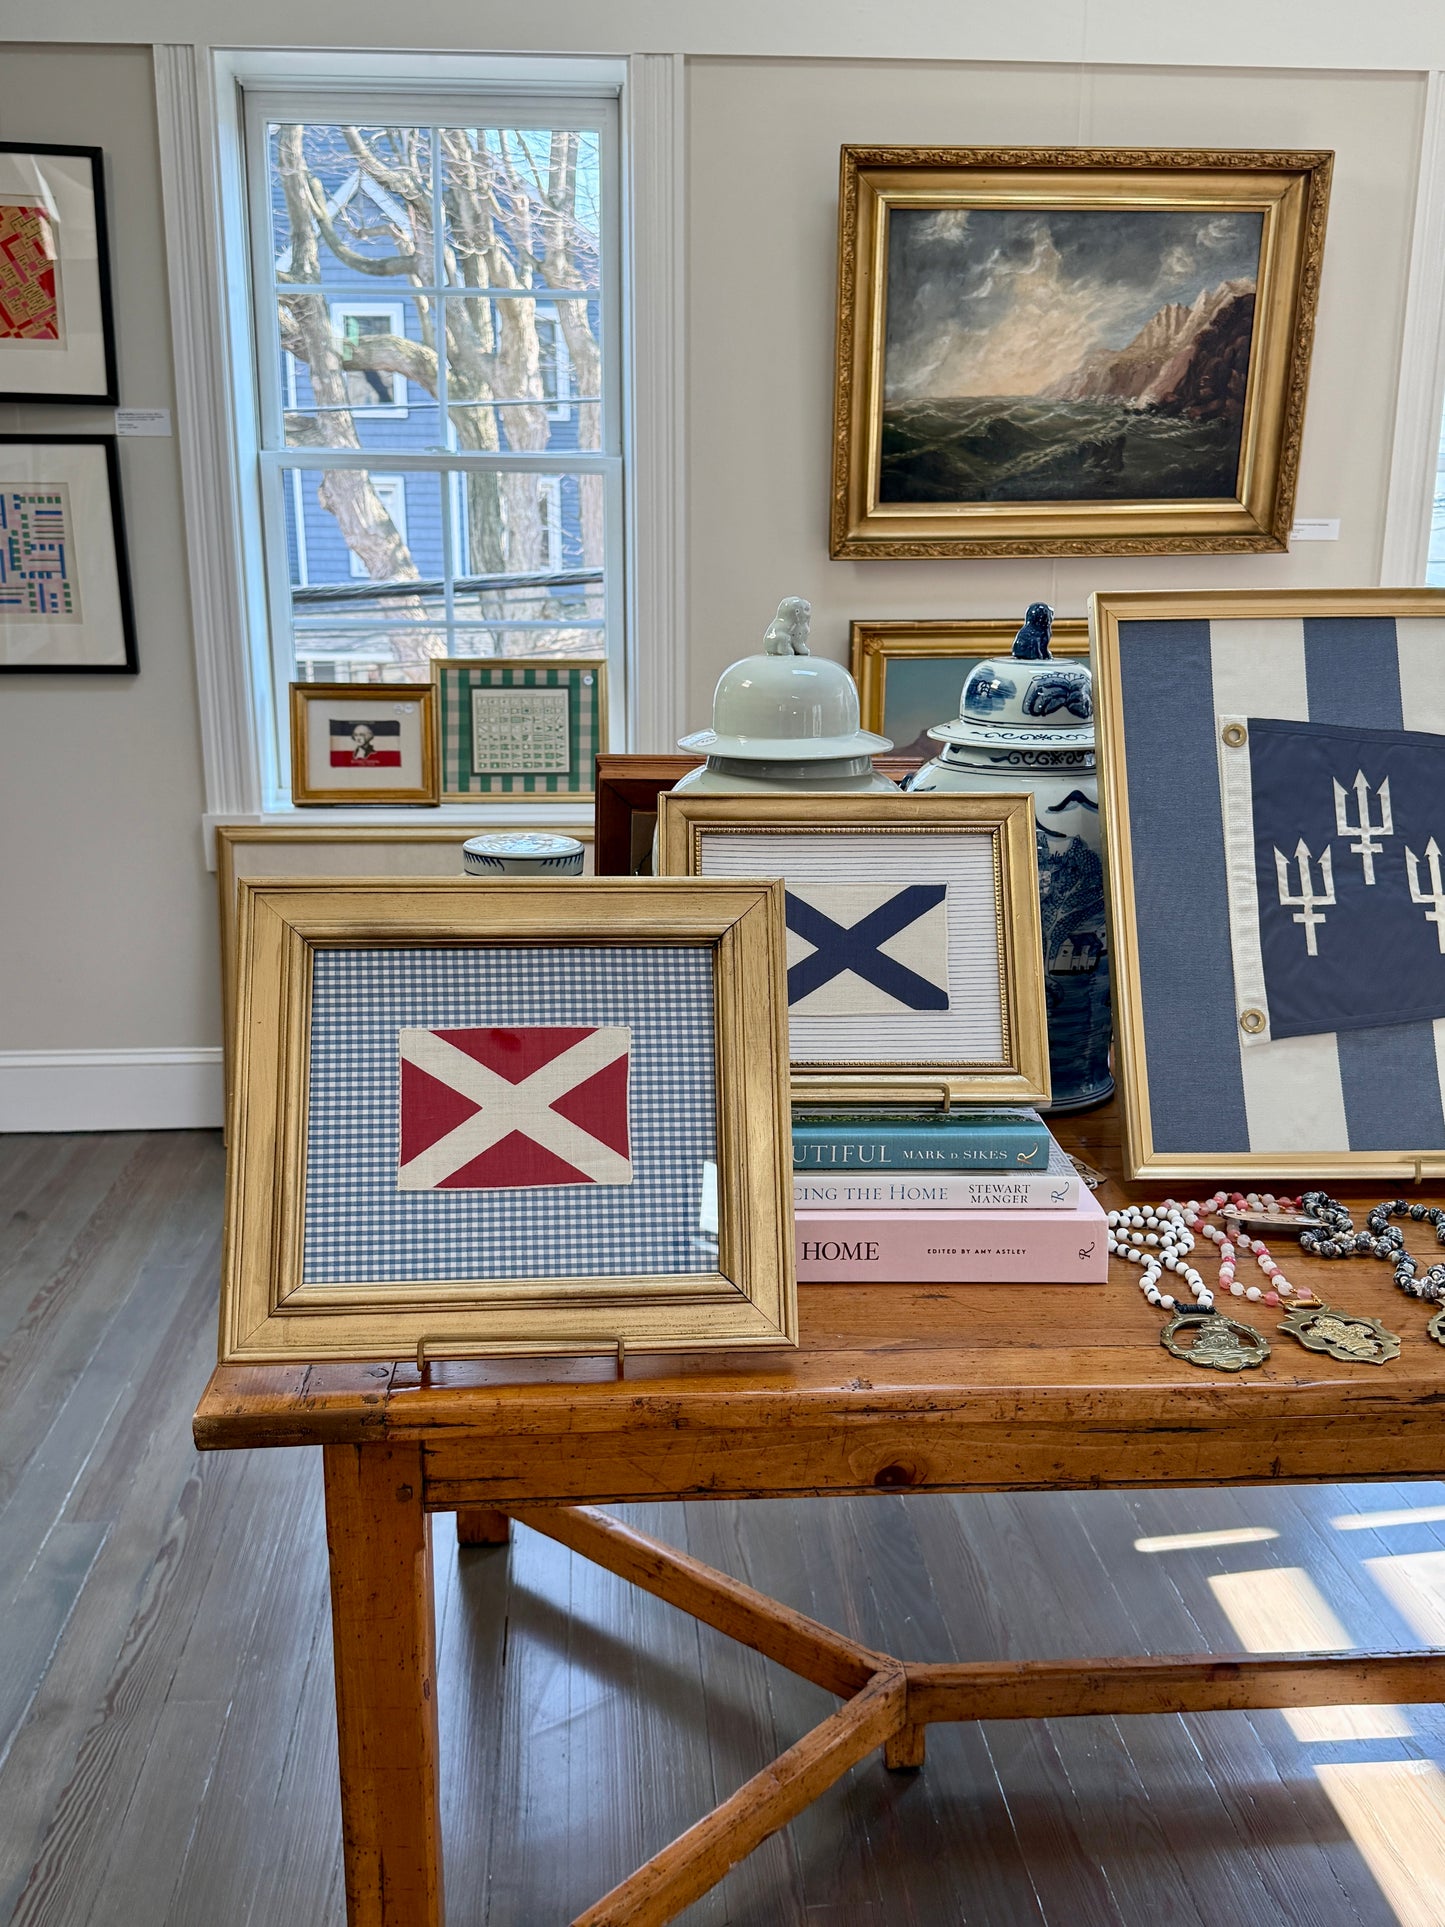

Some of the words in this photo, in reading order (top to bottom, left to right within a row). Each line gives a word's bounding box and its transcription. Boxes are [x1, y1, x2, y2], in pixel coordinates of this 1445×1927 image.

[792, 1145, 892, 1162] UTIFUL
[903, 1150, 946, 1160] MARK
[963, 1150, 1008, 1160] SIKES
[793, 1187, 838, 1201] CING
[844, 1187, 882, 1201] THE
[889, 1184, 949, 1201] HOME
[968, 1184, 1031, 1194] STEWART
[970, 1194, 1029, 1204] MANGER
[801, 1241, 880, 1261] HOME
